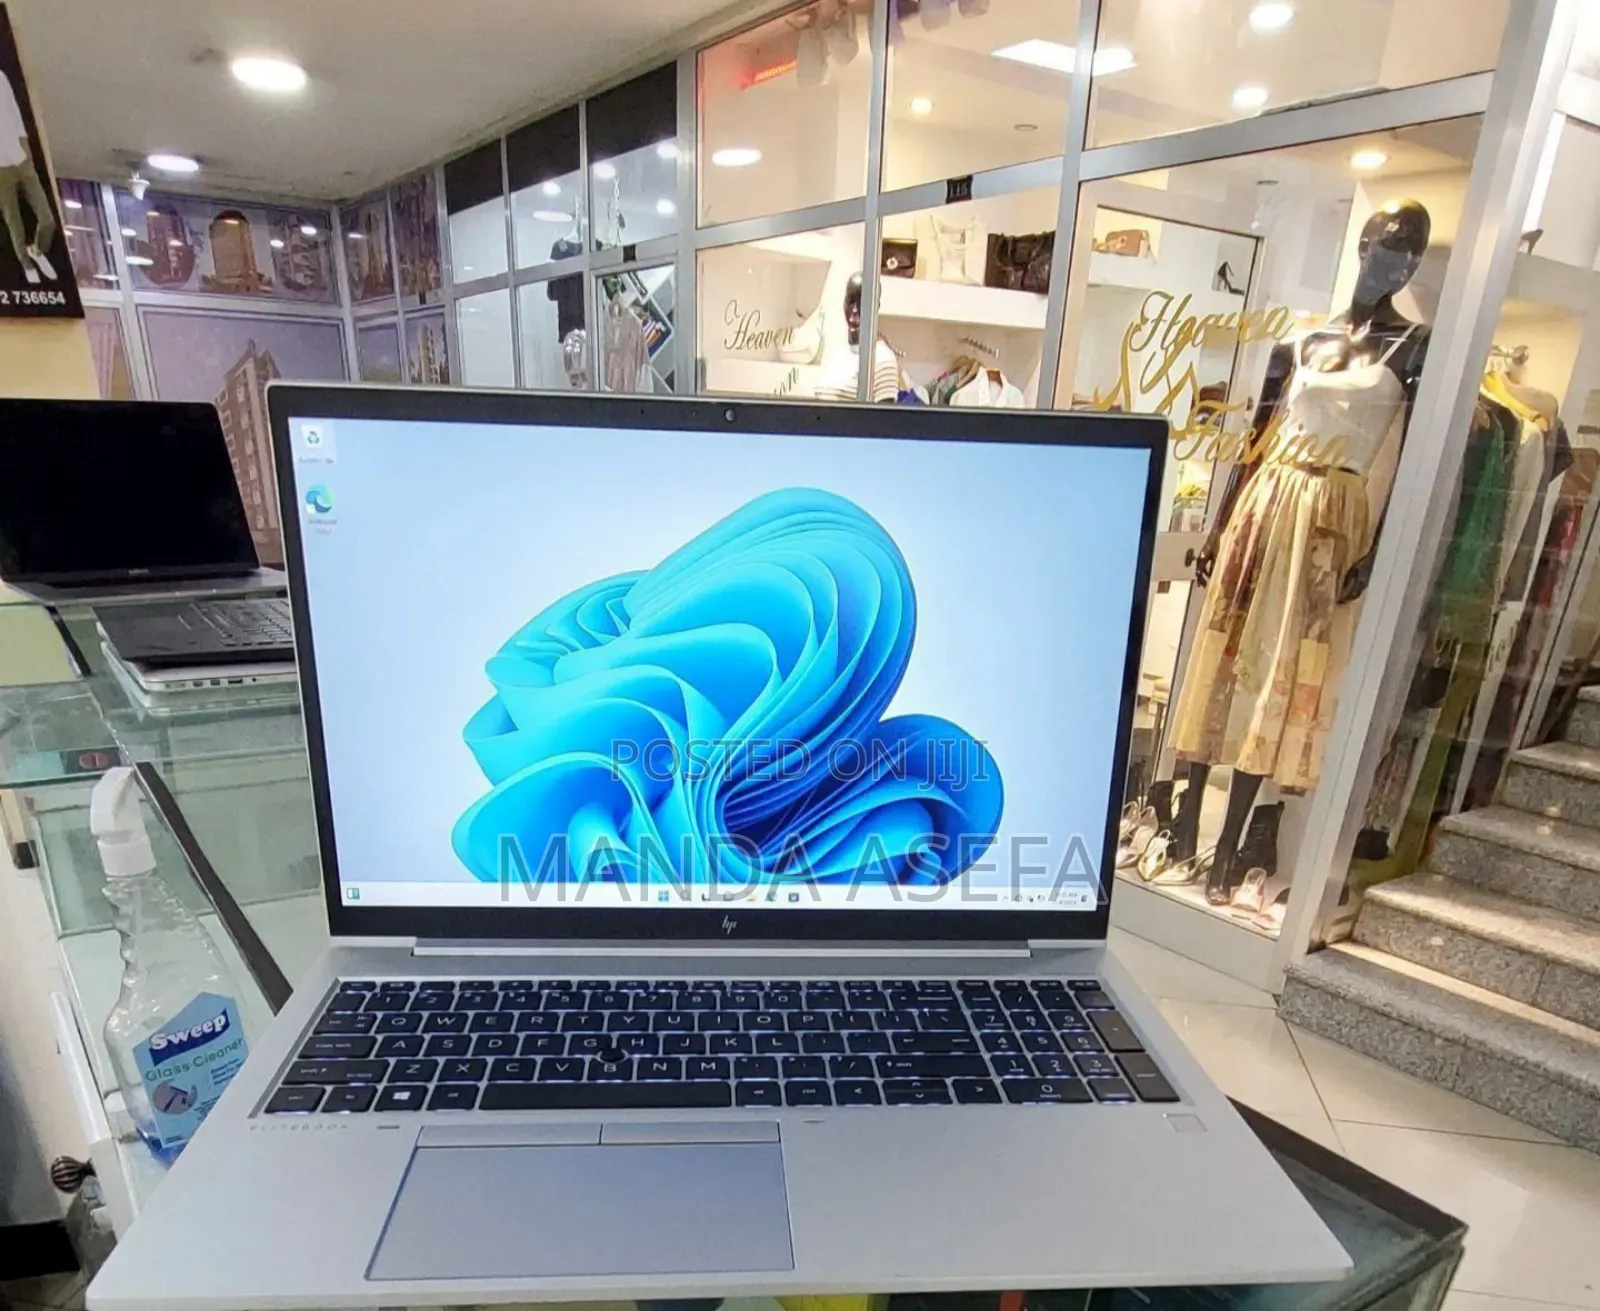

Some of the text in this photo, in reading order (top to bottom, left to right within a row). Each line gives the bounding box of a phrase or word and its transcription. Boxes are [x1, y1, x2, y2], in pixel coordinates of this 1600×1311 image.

[12, 290, 66, 305] 736654
[723, 299, 794, 351] Heaven
[1129, 289, 1294, 352] Heaven
[722, 914, 738, 935] hp
[391, 1015, 814, 1026] Q W E R T Y U I O P
[150, 1014, 227, 1050] Sweep
[392, 1037, 783, 1049] A S D F G H J K L
[144, 1061, 191, 1083] Glass
[192, 1037, 243, 1069] Cleaner
[405, 1064, 421, 1074] Z
[456, 1063, 471, 1073] X
[505, 1063, 520, 1072] C
[555, 1062, 569, 1072] V
[604, 1063, 617, 1073] B
[653, 1062, 667, 1072] N
[701, 1062, 716, 1072] M
